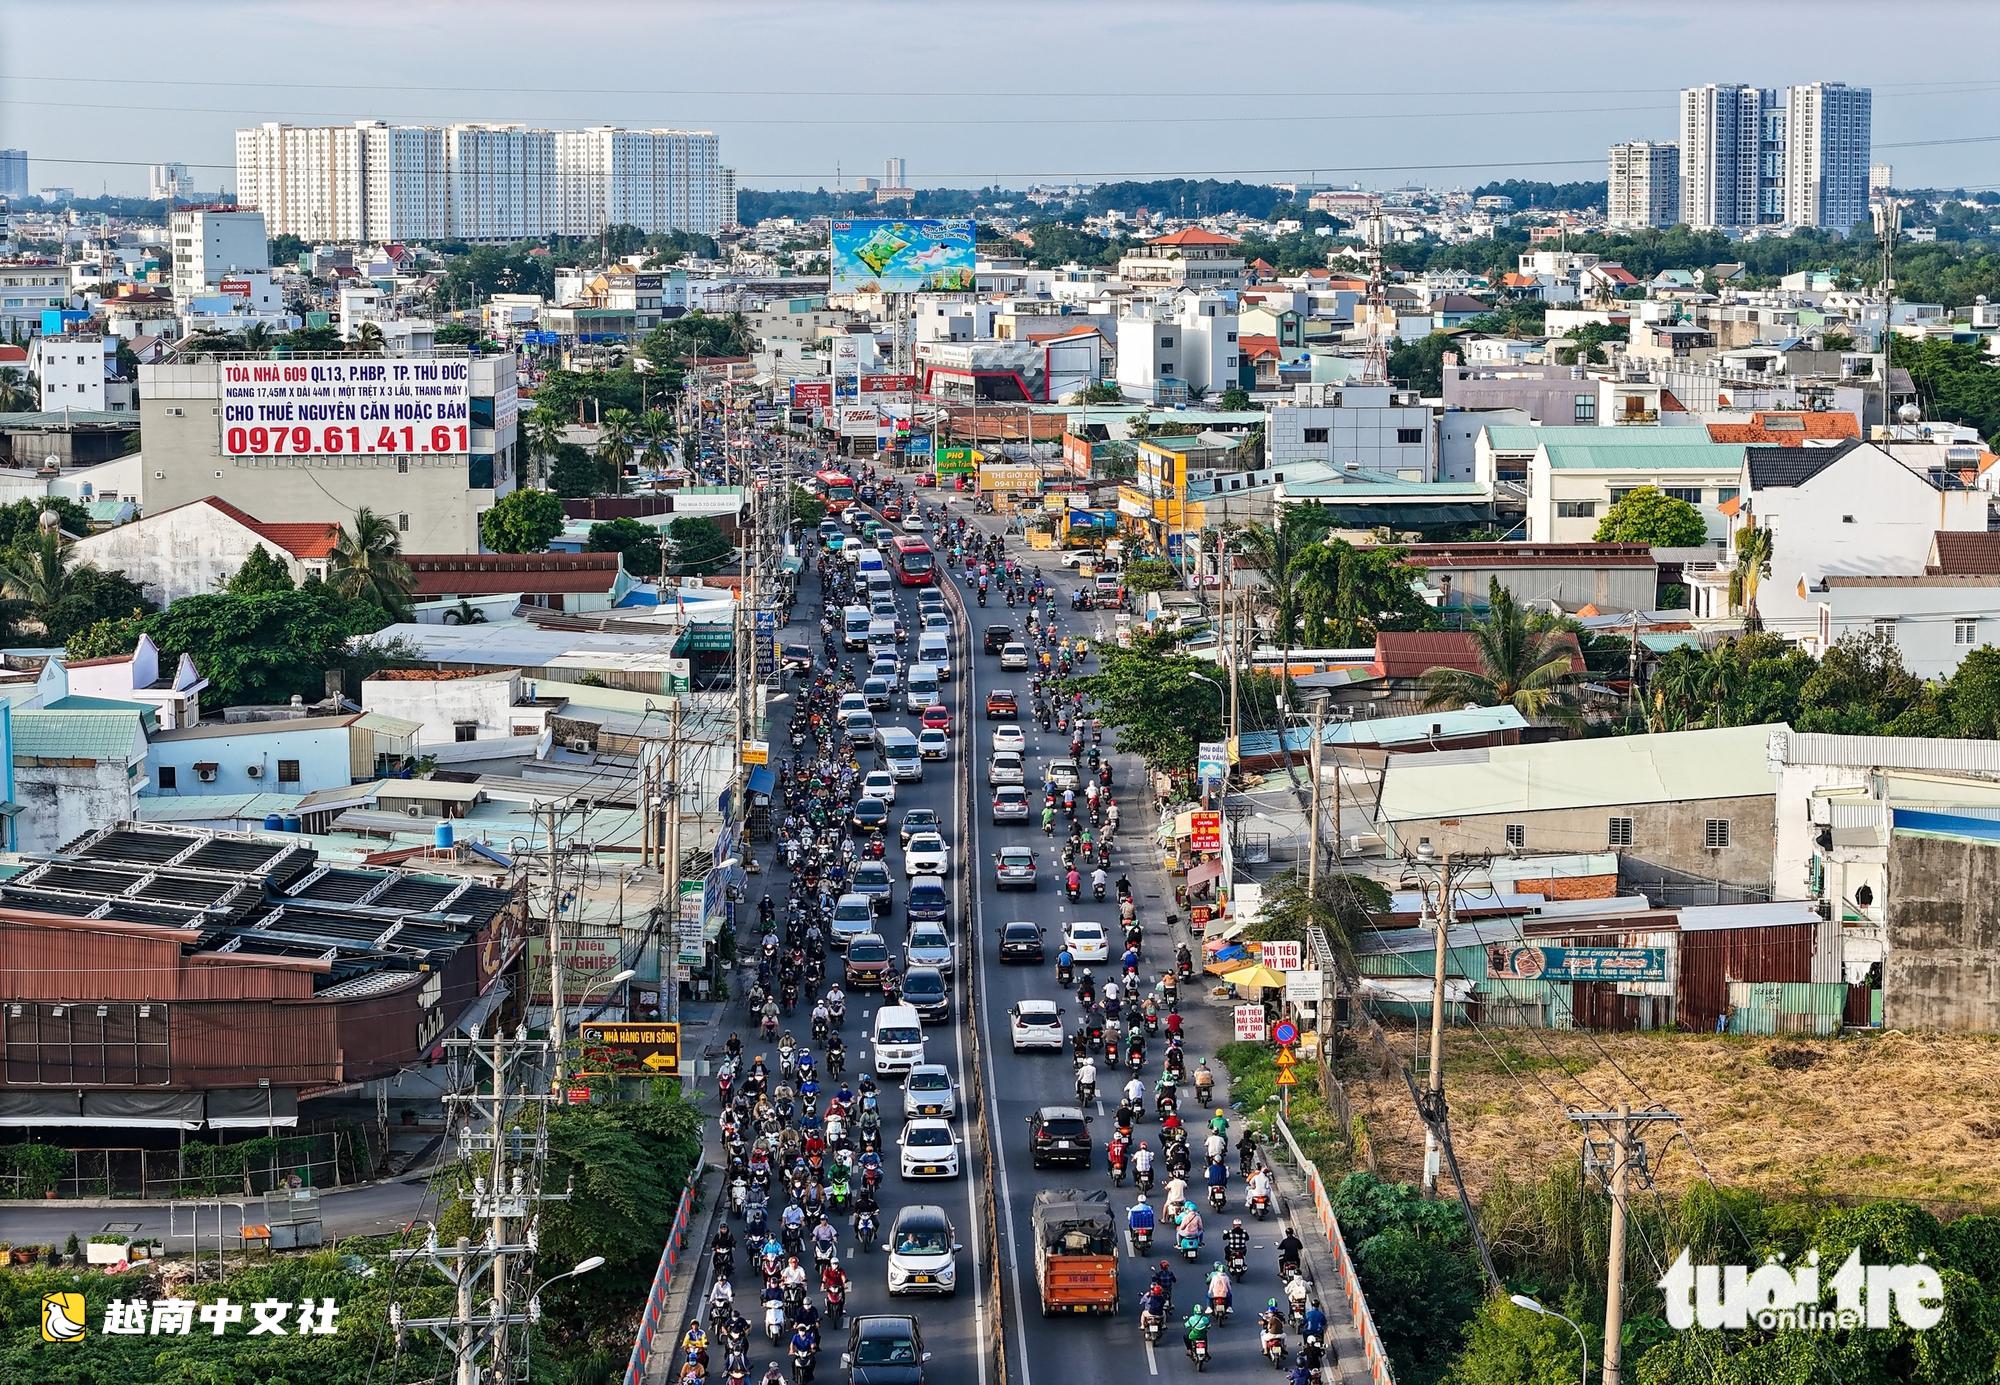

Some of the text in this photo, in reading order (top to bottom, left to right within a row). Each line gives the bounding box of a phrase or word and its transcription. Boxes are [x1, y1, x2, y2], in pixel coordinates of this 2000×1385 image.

[226, 360, 467, 383] TÒA NHÀ 609 QL13, P.HBP, TP. THỦ ĐỨC
[226, 386, 254, 398] NGANG
[257, 386, 286, 399] 17,45M
[289, 387, 295, 397] X
[296, 384, 311, 397] DÀI
[312, 387, 330, 397] 44M
[338, 384, 356, 398] MỘT
[357, 384, 378, 399] TRỆT
[380, 386, 385, 396] X
[387, 386, 392, 396] 3
[415, 385, 442, 396] THANG
[444, 383, 460, 396] MÁY
[226, 399, 466, 423] CHO THUÊ NGUYÊN CĂN HOẶC BÁN
[227, 425, 467, 454] 0979.61.41.61
[946, 450, 963, 459] PHỞ
[545, 940, 605, 951] Cm Niêu
[1264, 943, 1297, 956] HỦ TIẾU
[1264, 957, 1296, 968] MỸ THO
[1237, 1007, 1262, 1016] HỦ TIẾU
[603, 1029, 675, 1043] NHÀ HÀNG VEN SÔNG
